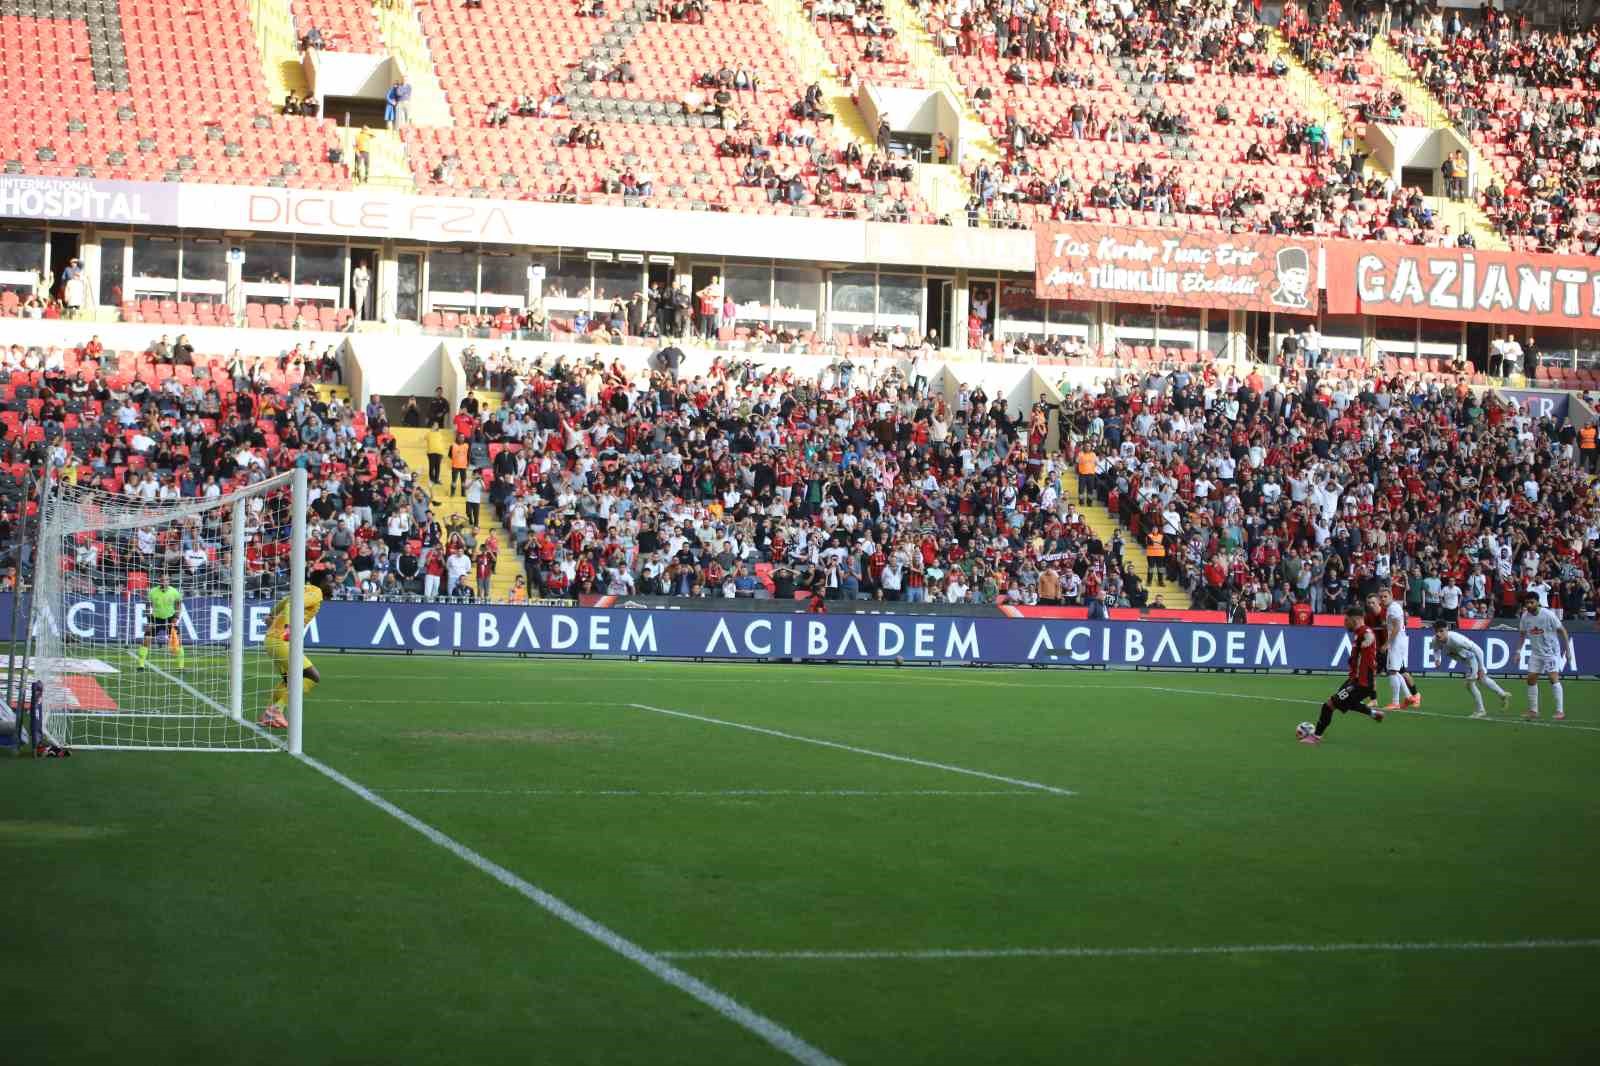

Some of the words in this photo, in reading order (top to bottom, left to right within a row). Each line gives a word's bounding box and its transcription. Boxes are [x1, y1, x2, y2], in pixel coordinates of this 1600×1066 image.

[0, 178, 96, 191] INTERNATIONAL
[0, 188, 149, 221] HOSPITAL
[371, 607, 658, 652] ACIBADEM
[705, 617, 980, 659] ACIBADEM
[1027, 624, 1288, 666] ACIBADEM
